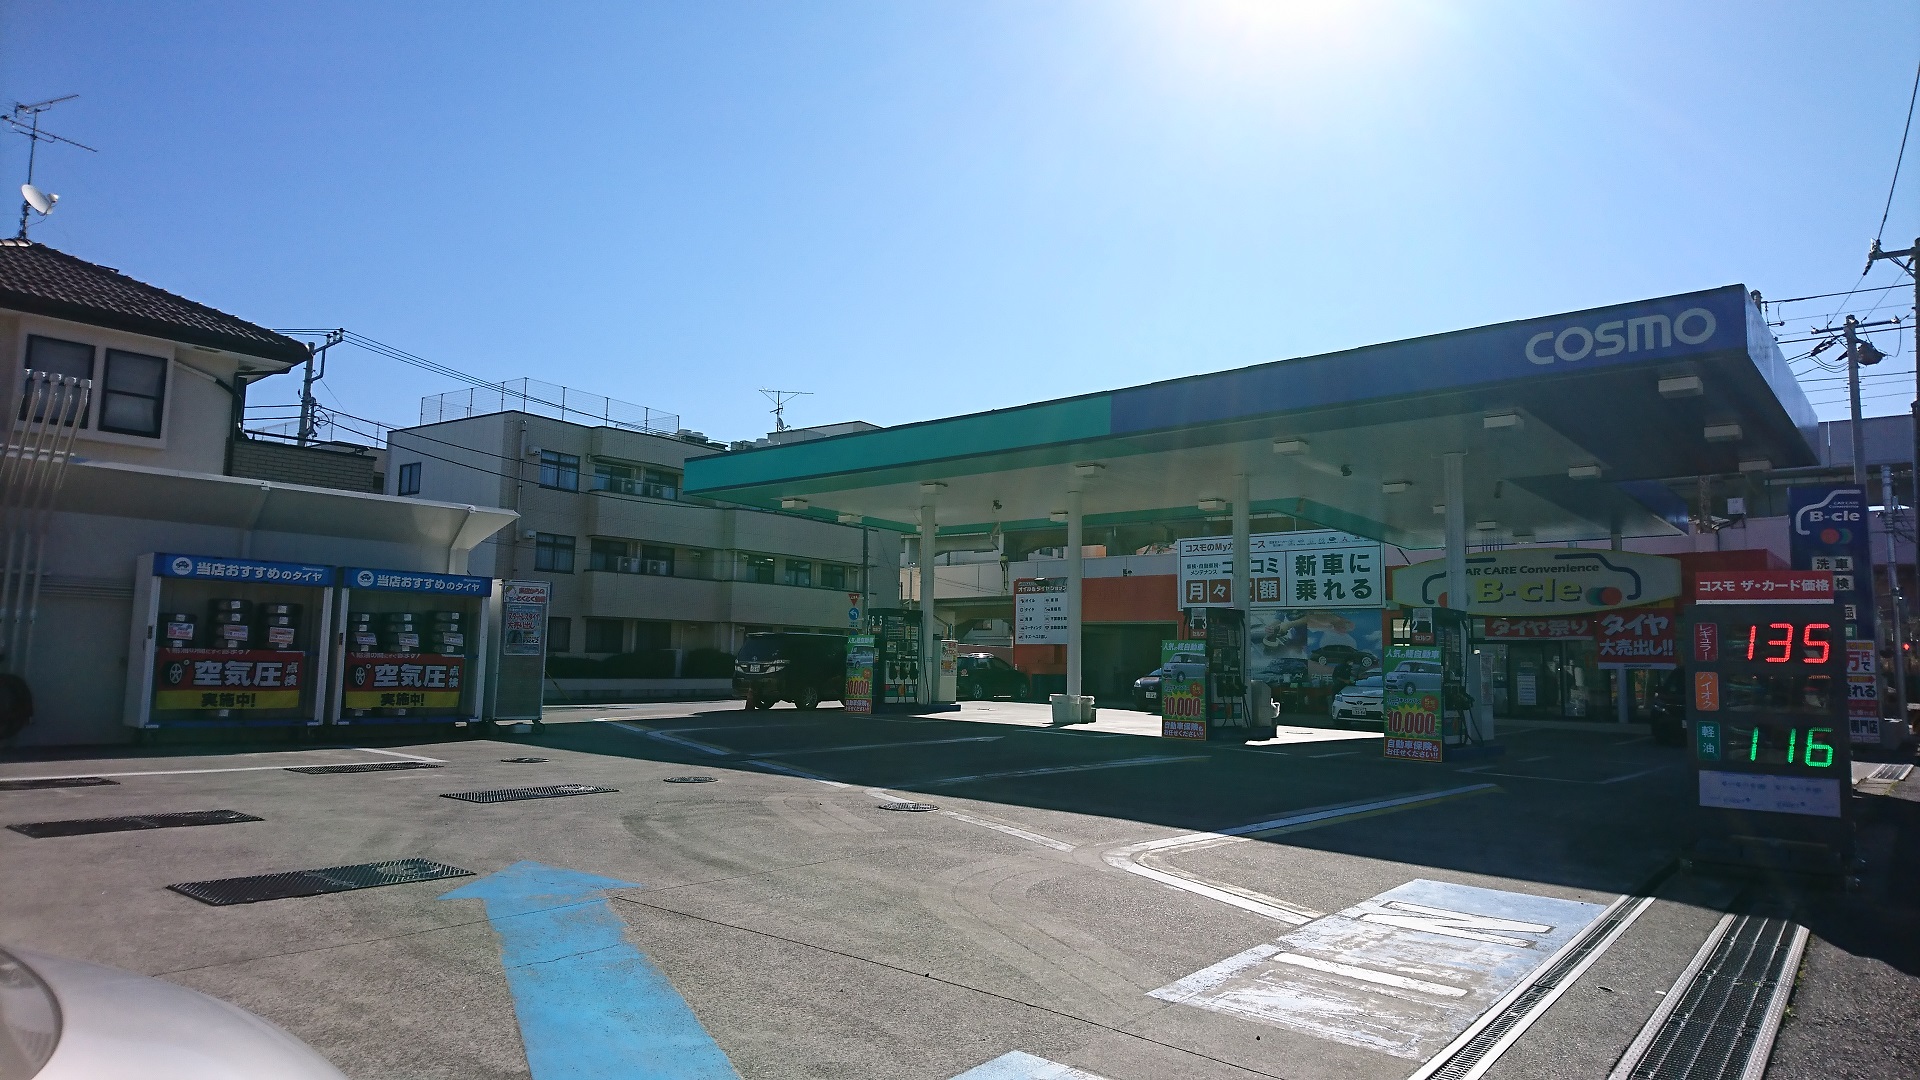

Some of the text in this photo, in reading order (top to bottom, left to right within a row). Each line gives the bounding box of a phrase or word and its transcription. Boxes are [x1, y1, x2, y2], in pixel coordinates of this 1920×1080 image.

[1525, 308, 1717, 365] COSMO
[1809, 510, 1860, 522] B-cle
[1186, 540, 1265, 552] コスモのMyカース
[196, 562, 323, 582] 当店おすすめのタイヤ
[1222, 557, 1278, 574] ココミ
[1294, 553, 1371, 577] 新車に
[1465, 564, 1600, 576] AR CARE Convenience
[1816, 558, 1849, 570] 洗車
[376, 574, 480, 592] 当店おすすめのタイヤ
[1190, 580, 1278, 601] 月々額
[1295, 578, 1373, 601] 乗れる
[1474, 577, 1582, 604] B-cle
[1699, 579, 1830, 592] コスモ ザ・カード価格
[1202, 619, 1207, 629] 3
[1412, 620, 1418, 633] 2
[1491, 619, 1588, 636] タイヤ祭り
[1600, 614, 1669, 636] タイヤ
[1599, 639, 1674, 656] 大売出し!!
[1699, 624, 1712, 660] レギュラー
[1747, 622, 1830, 664] 135
[1386, 649, 1440, 658] 人気の軽自動車
[192, 660, 299, 687] 空気圧 点検
[373, 663, 447, 688] 空気圧
[201, 692, 256, 708] 実施中!
[381, 693, 425, 706] 実施中!
[1700, 674, 1713, 709] ハイオク
[1387, 712, 1435, 734] 10,000
[1387, 740, 1439, 752] 自動車保険も
[1701, 726, 1715, 754] 軽油
[1749, 726, 1834, 768] 116
[1386, 748, 1438, 759] お任せください!!
